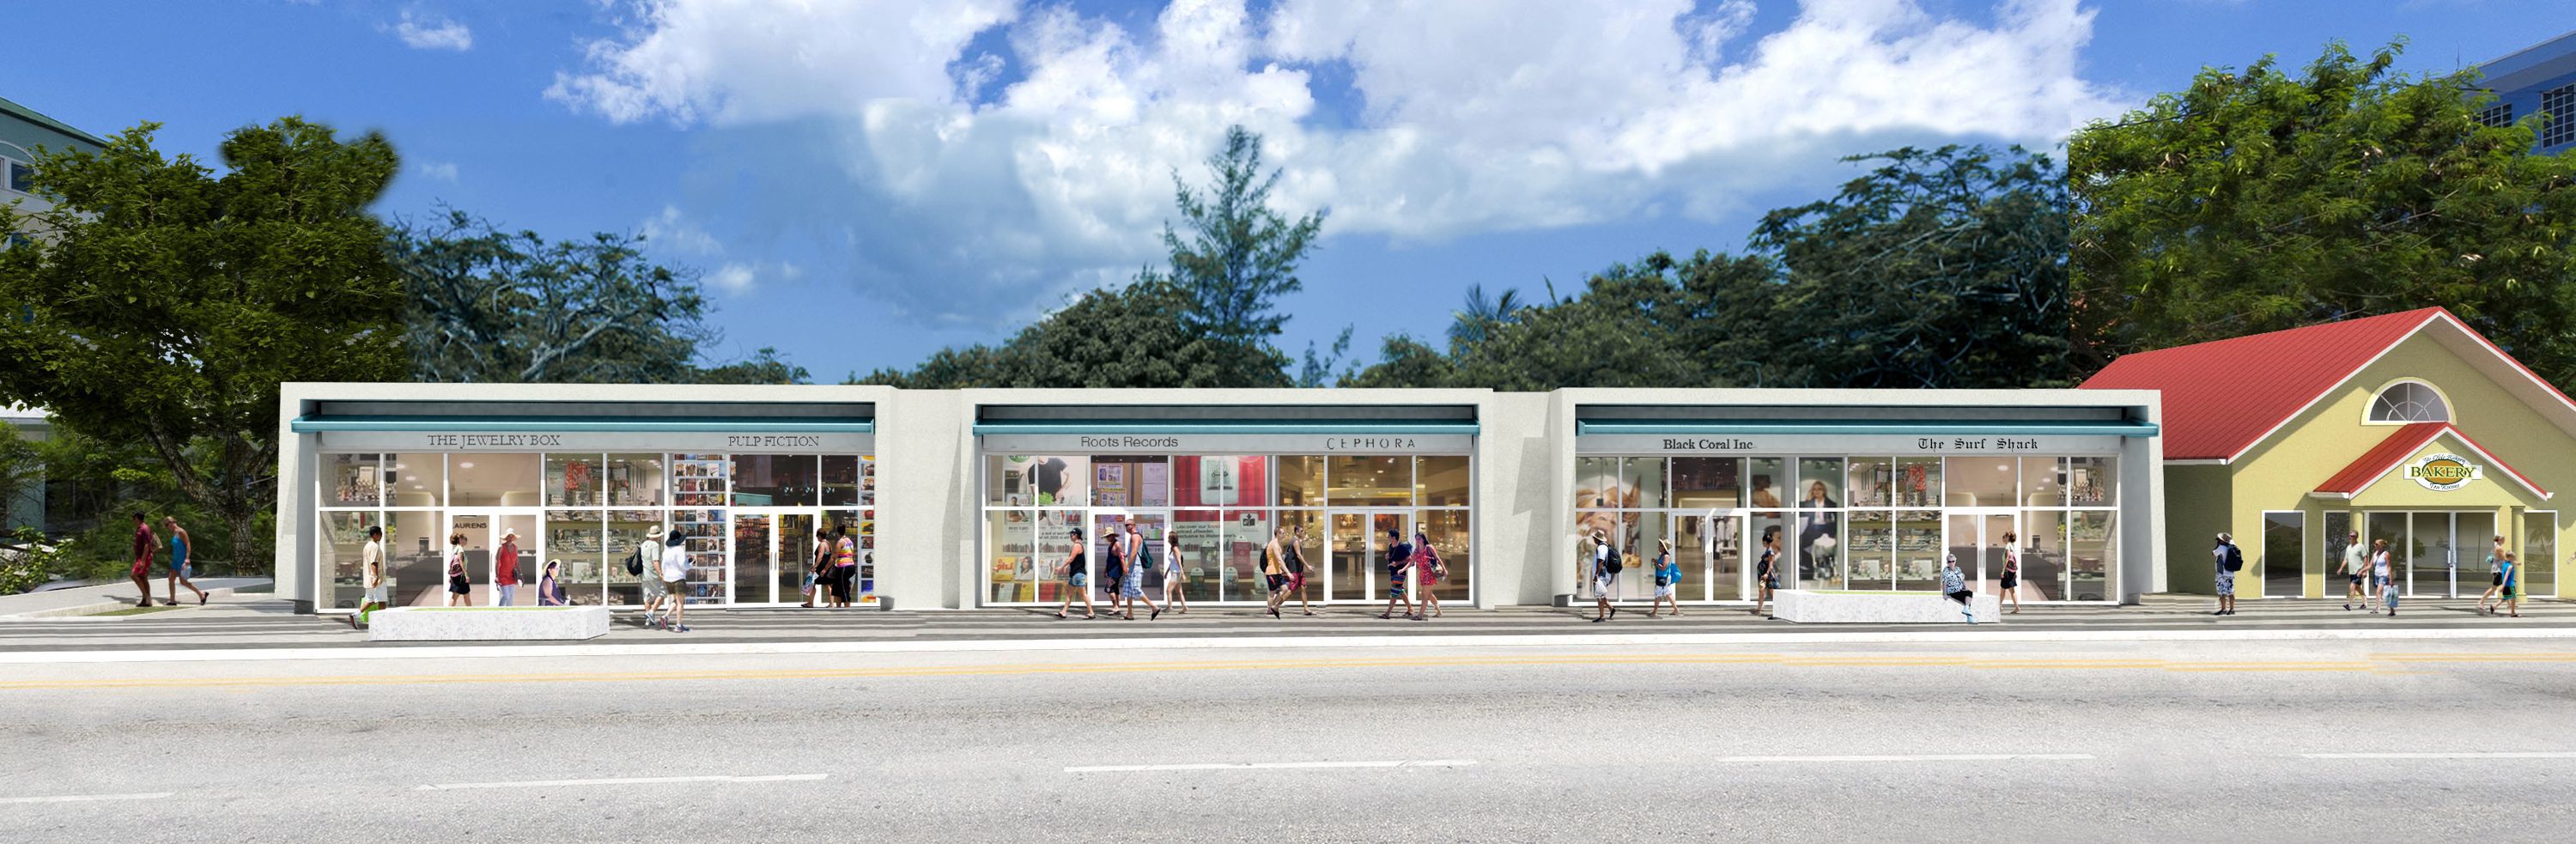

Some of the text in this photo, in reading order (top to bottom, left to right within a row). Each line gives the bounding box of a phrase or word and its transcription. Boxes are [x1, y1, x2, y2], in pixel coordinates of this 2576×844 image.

[428, 434, 562, 449] THE JEWELRY BOX
[728, 435, 820, 446] PULP FICTION
[1081, 436, 1179, 447] Roots Records
[1327, 438, 1415, 450] CEPHORA
[1662, 439, 1753, 450] Black Coral Inc
[1917, 437, 2038, 452] The Surf Shack
[2410, 466, 2477, 477] BAKERY
